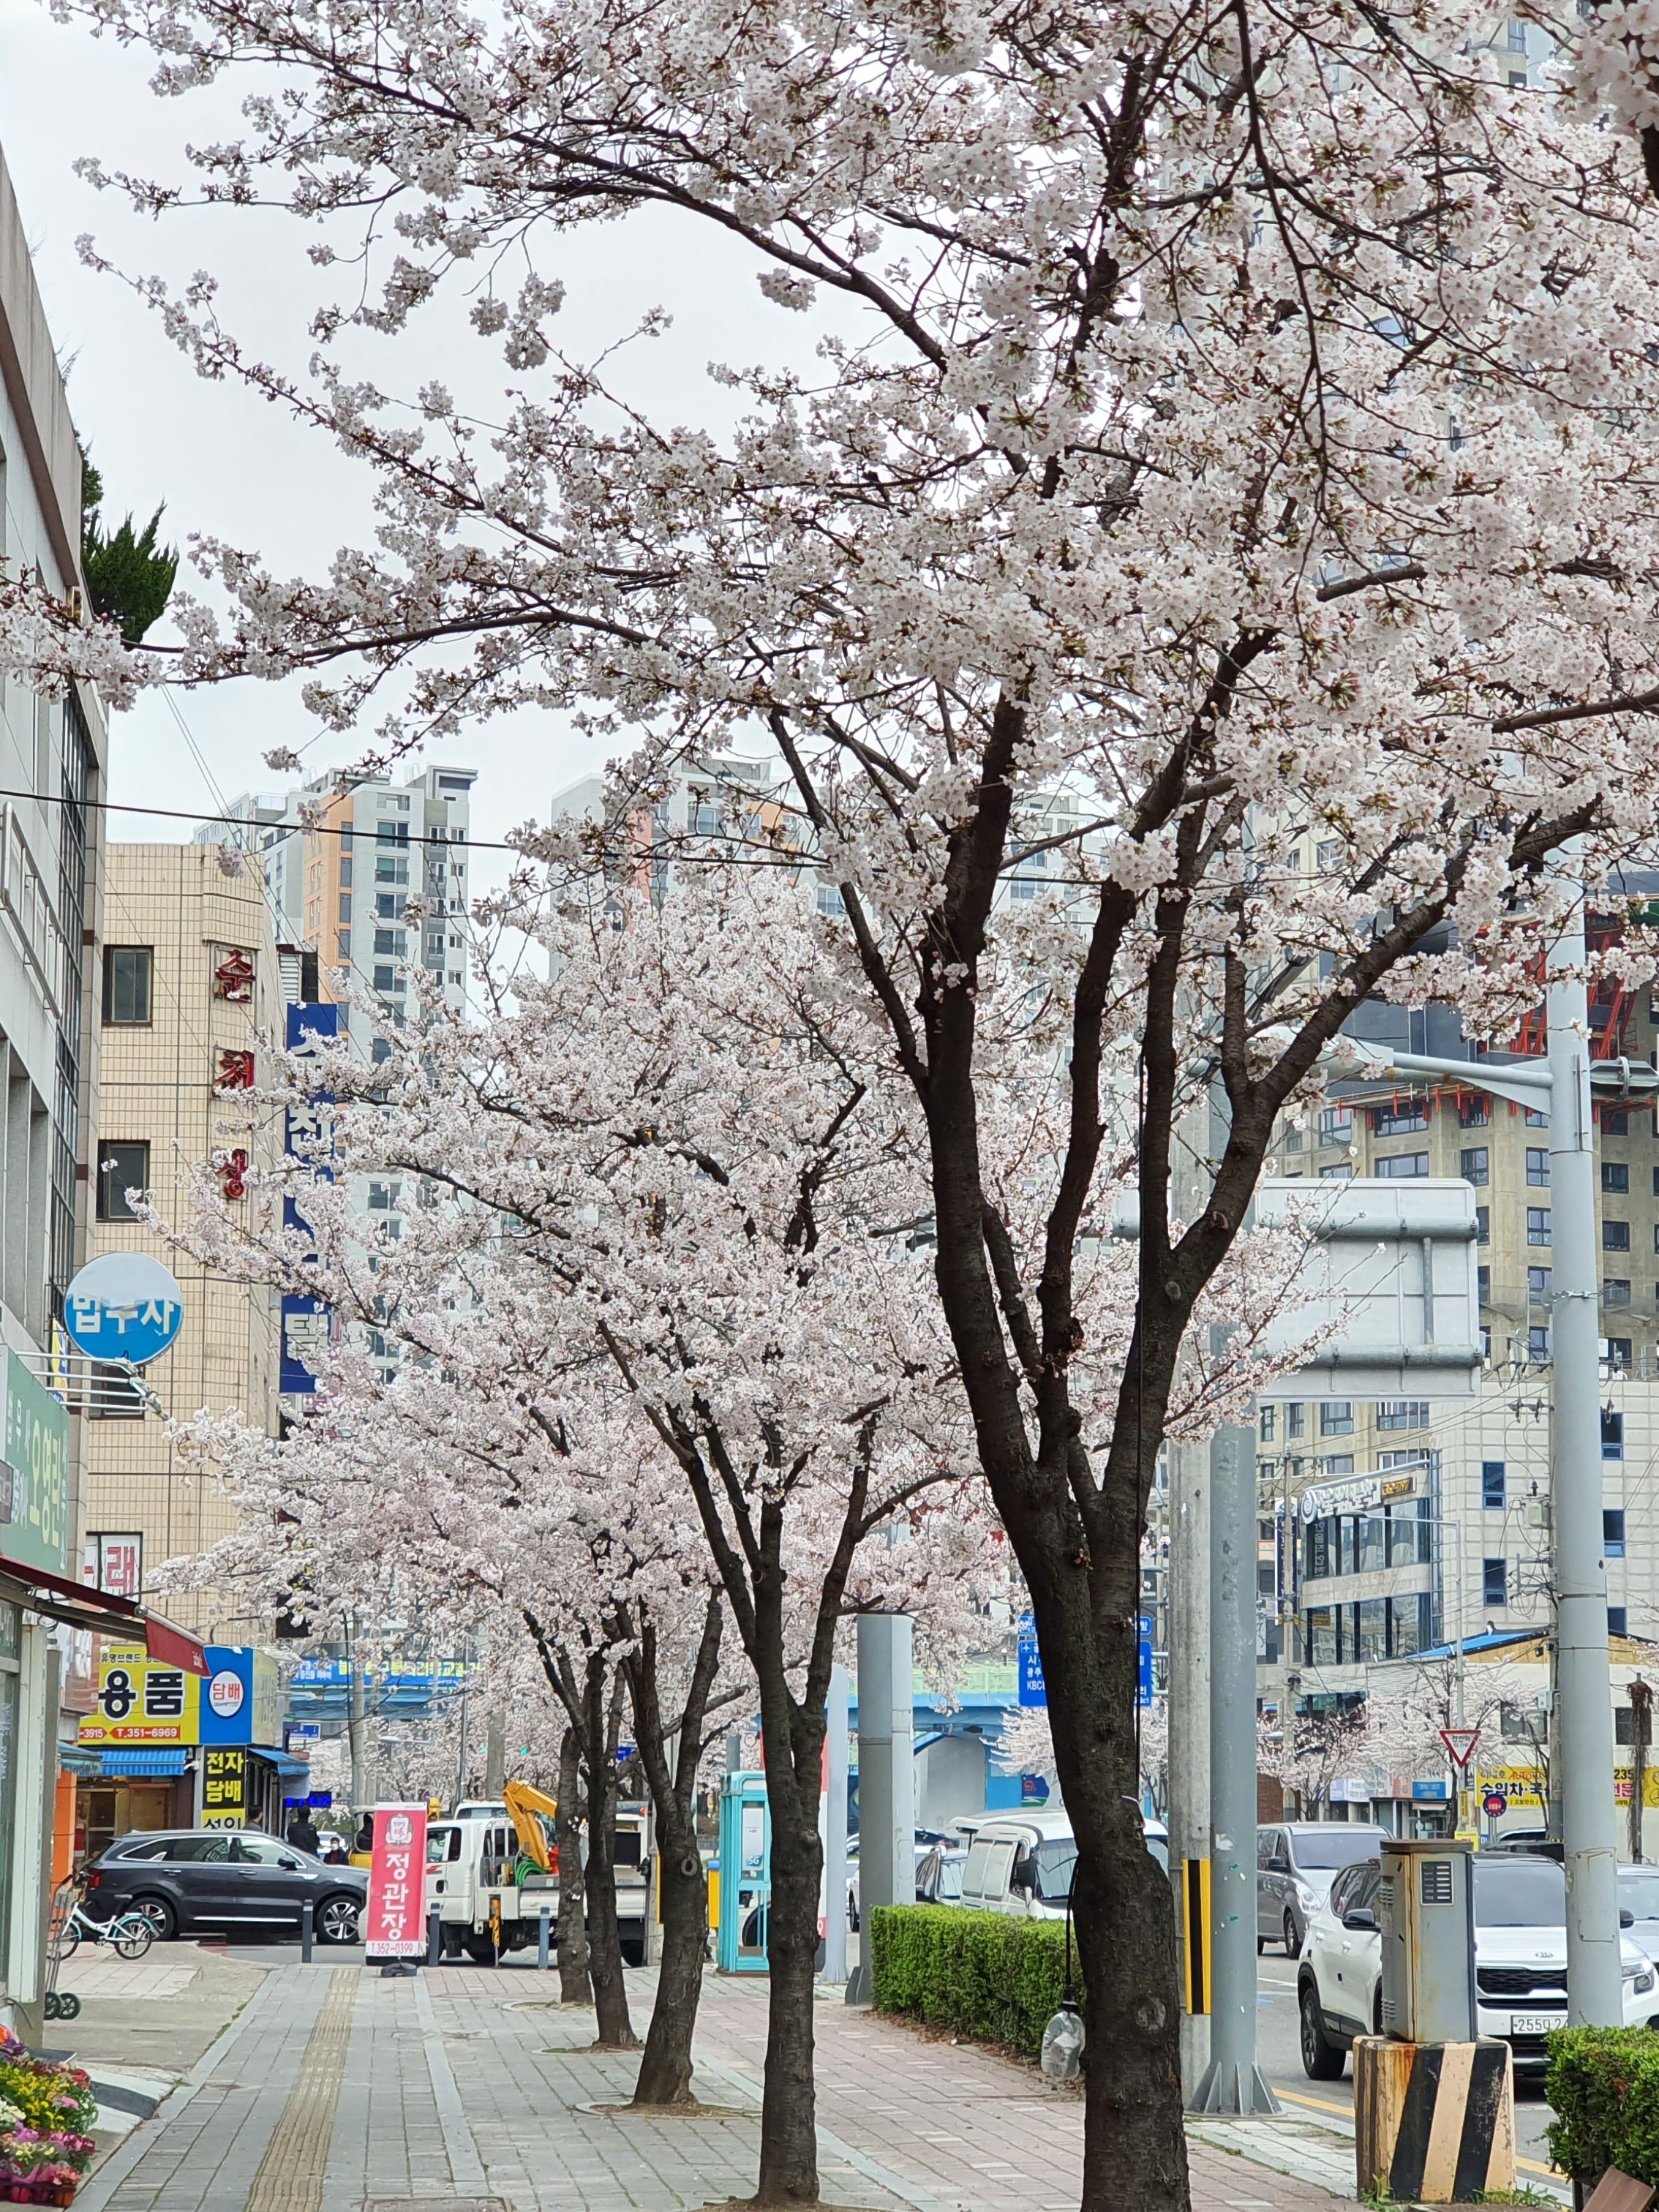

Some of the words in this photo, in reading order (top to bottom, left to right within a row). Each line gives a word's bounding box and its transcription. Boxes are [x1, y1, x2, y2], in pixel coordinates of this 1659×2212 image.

[30, 1418, 61, 1549] 오영란
[102, 1653, 141, 1663] 유명브랜드
[213, 1683, 240, 1700] 담배
[116, 1728, 178, 1739] T.351-6969
[206, 1751, 244, 1775] 전자
[206, 1780, 242, 1803] 담배
[380, 1853, 410, 1941] 정관장
[371, 1942, 414, 1955] T.352-0399
